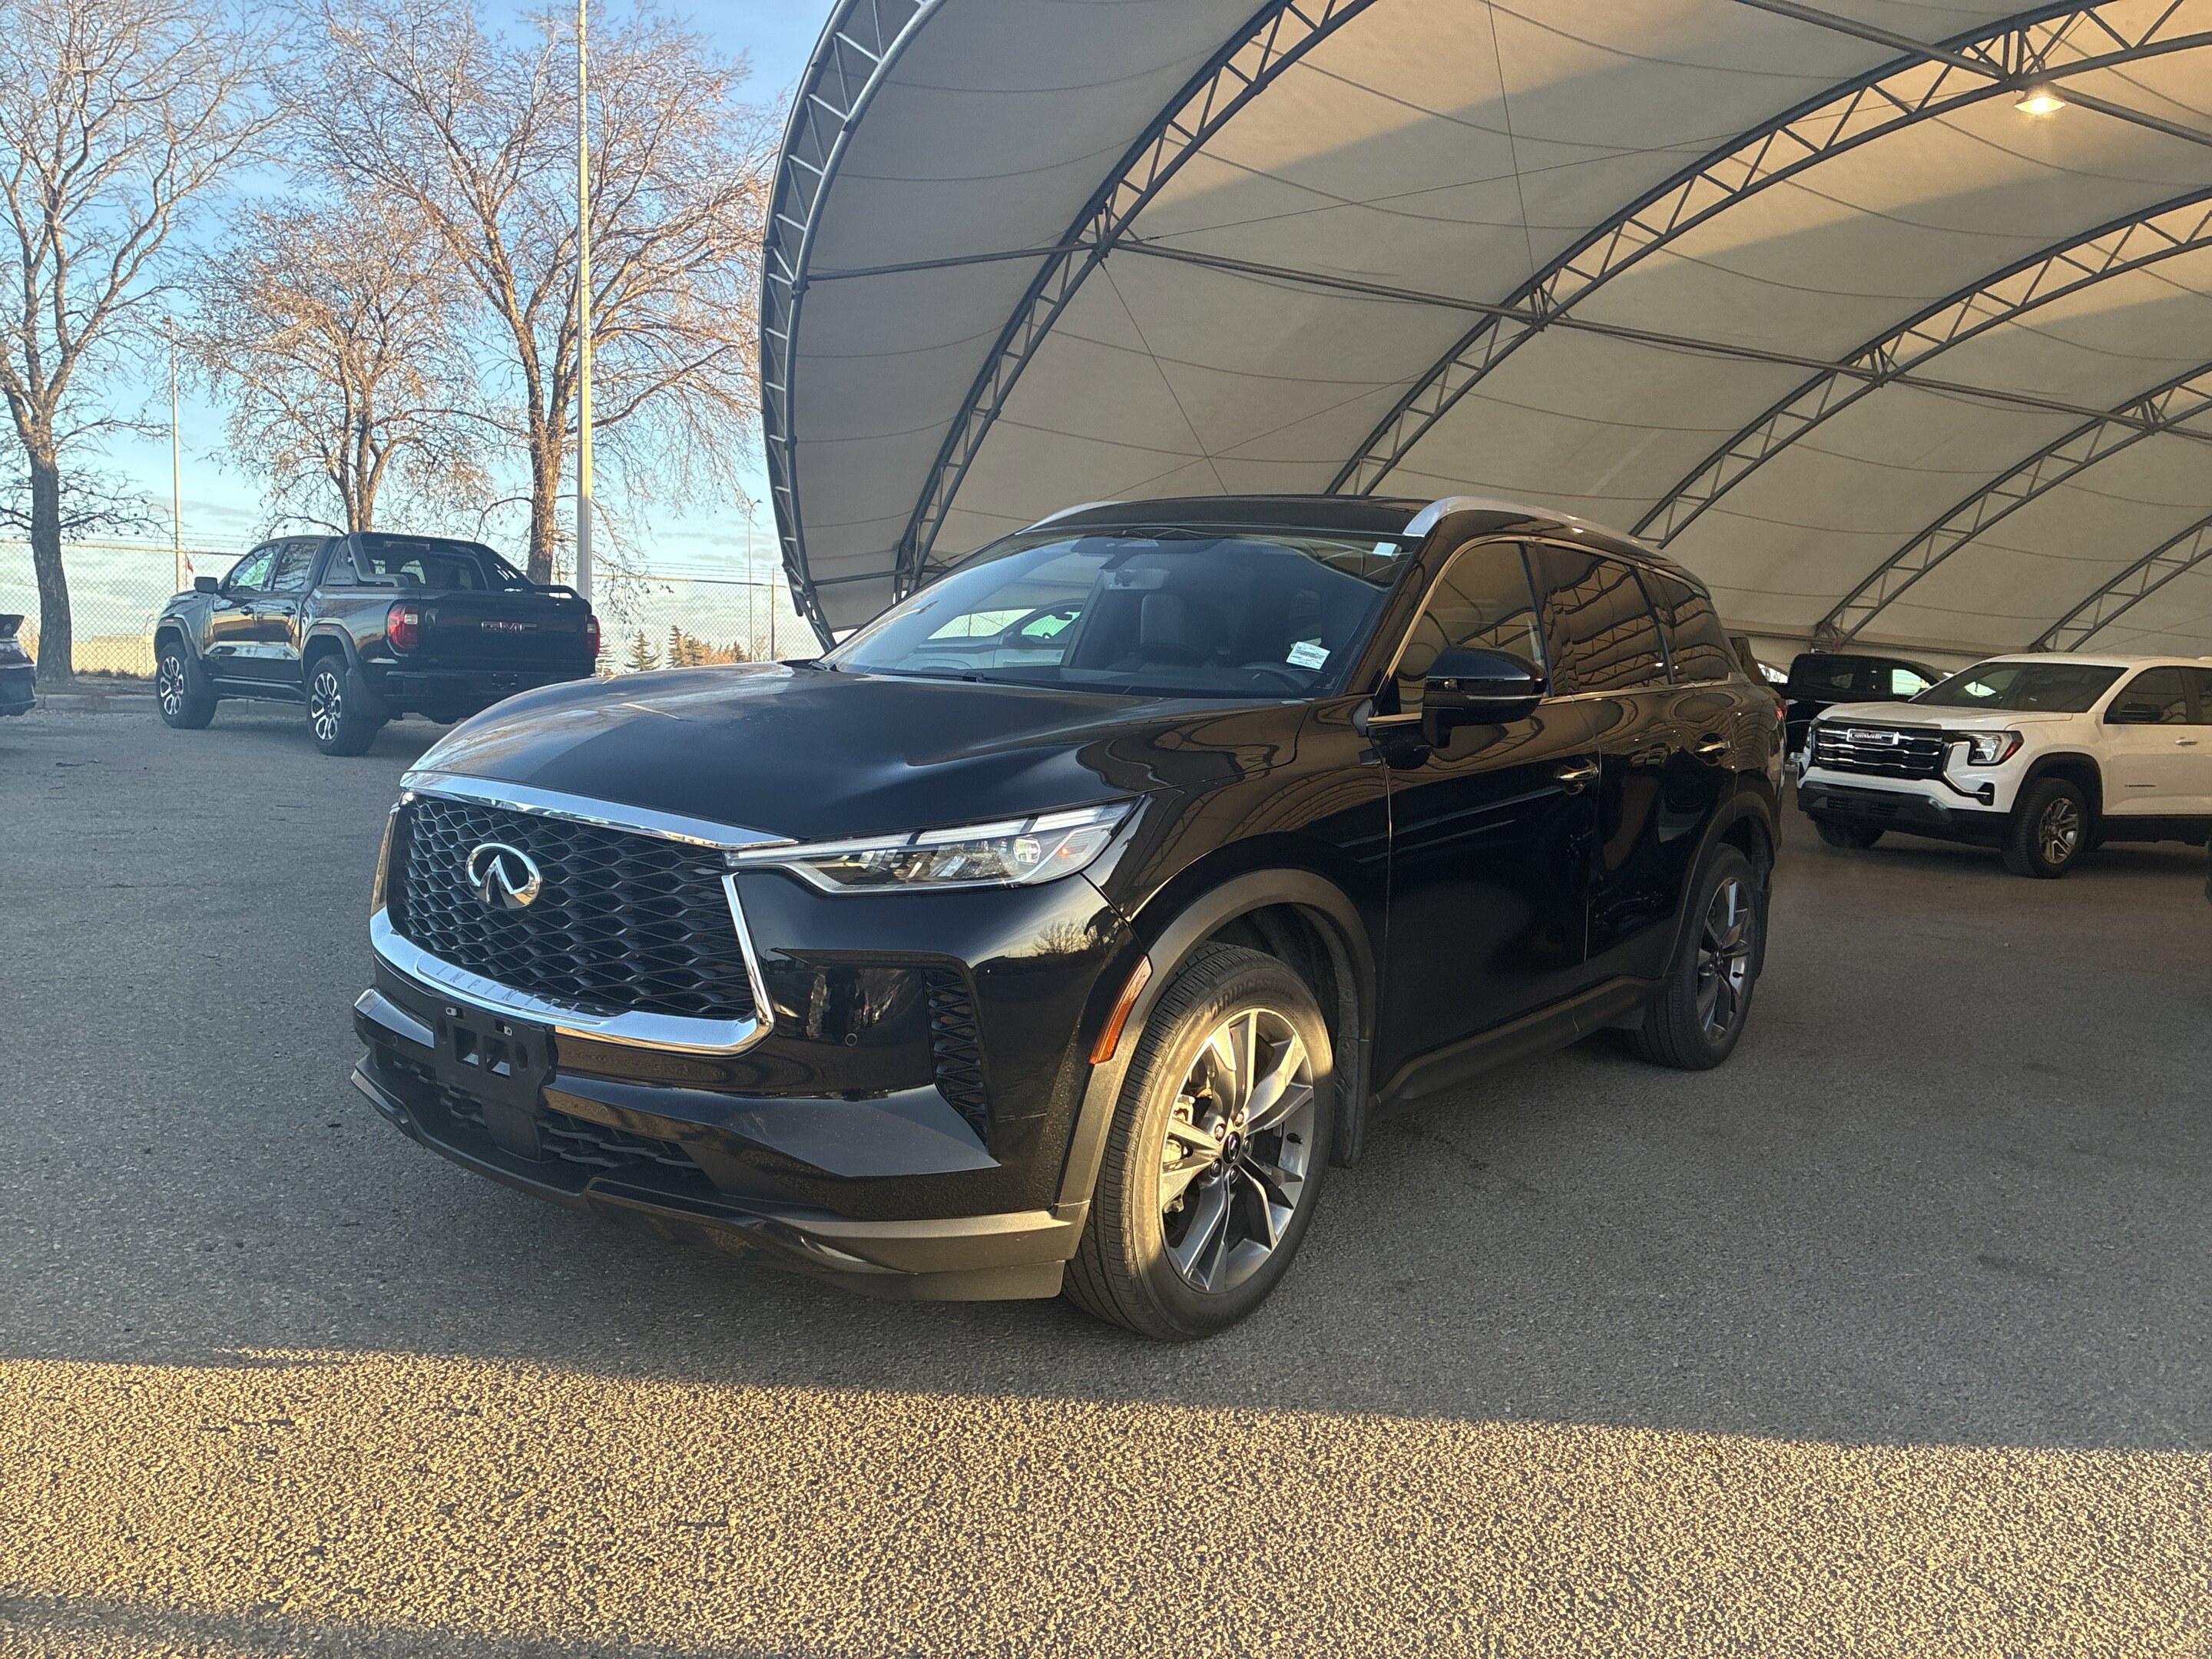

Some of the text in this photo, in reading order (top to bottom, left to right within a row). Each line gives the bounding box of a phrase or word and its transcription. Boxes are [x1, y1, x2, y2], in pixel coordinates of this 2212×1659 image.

[481, 621, 538, 635] GMC
[436, 965, 580, 1015] INFINITI
[1210, 978, 1295, 1022] BRIDGESTONE
